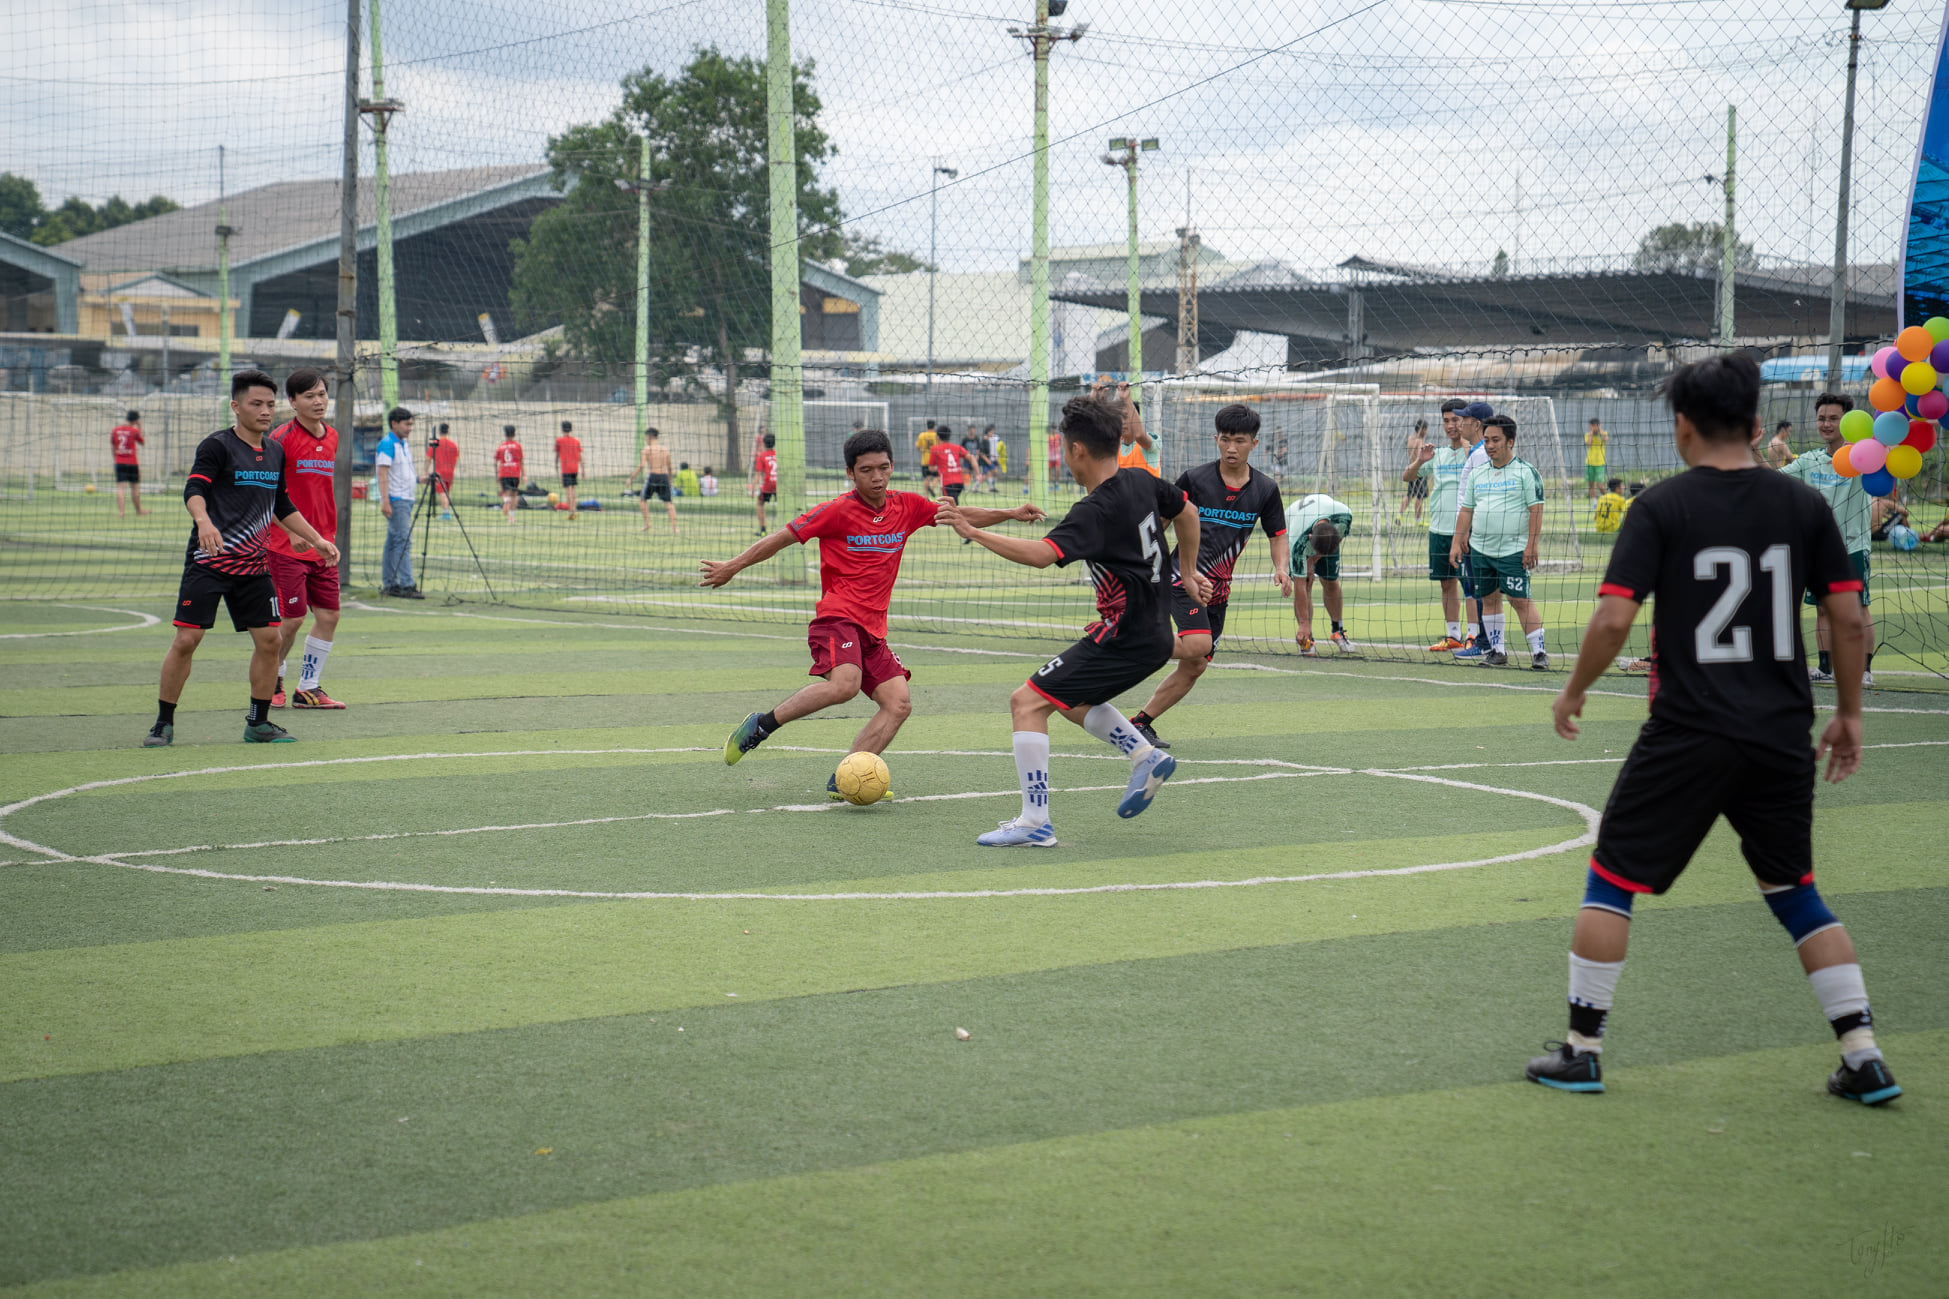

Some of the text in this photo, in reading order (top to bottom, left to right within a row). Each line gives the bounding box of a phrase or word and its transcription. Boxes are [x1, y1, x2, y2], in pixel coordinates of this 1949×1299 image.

[296, 459, 335, 469] PORTCOAS
[235, 470, 280, 481] PORTCOAST
[1198, 506, 1258, 521] PORTCOAST
[1138, 511, 1163, 583] 5
[1506, 576, 1524, 592] 52
[1693, 544, 1794, 664] 21
[1038, 656, 1065, 677] 5
